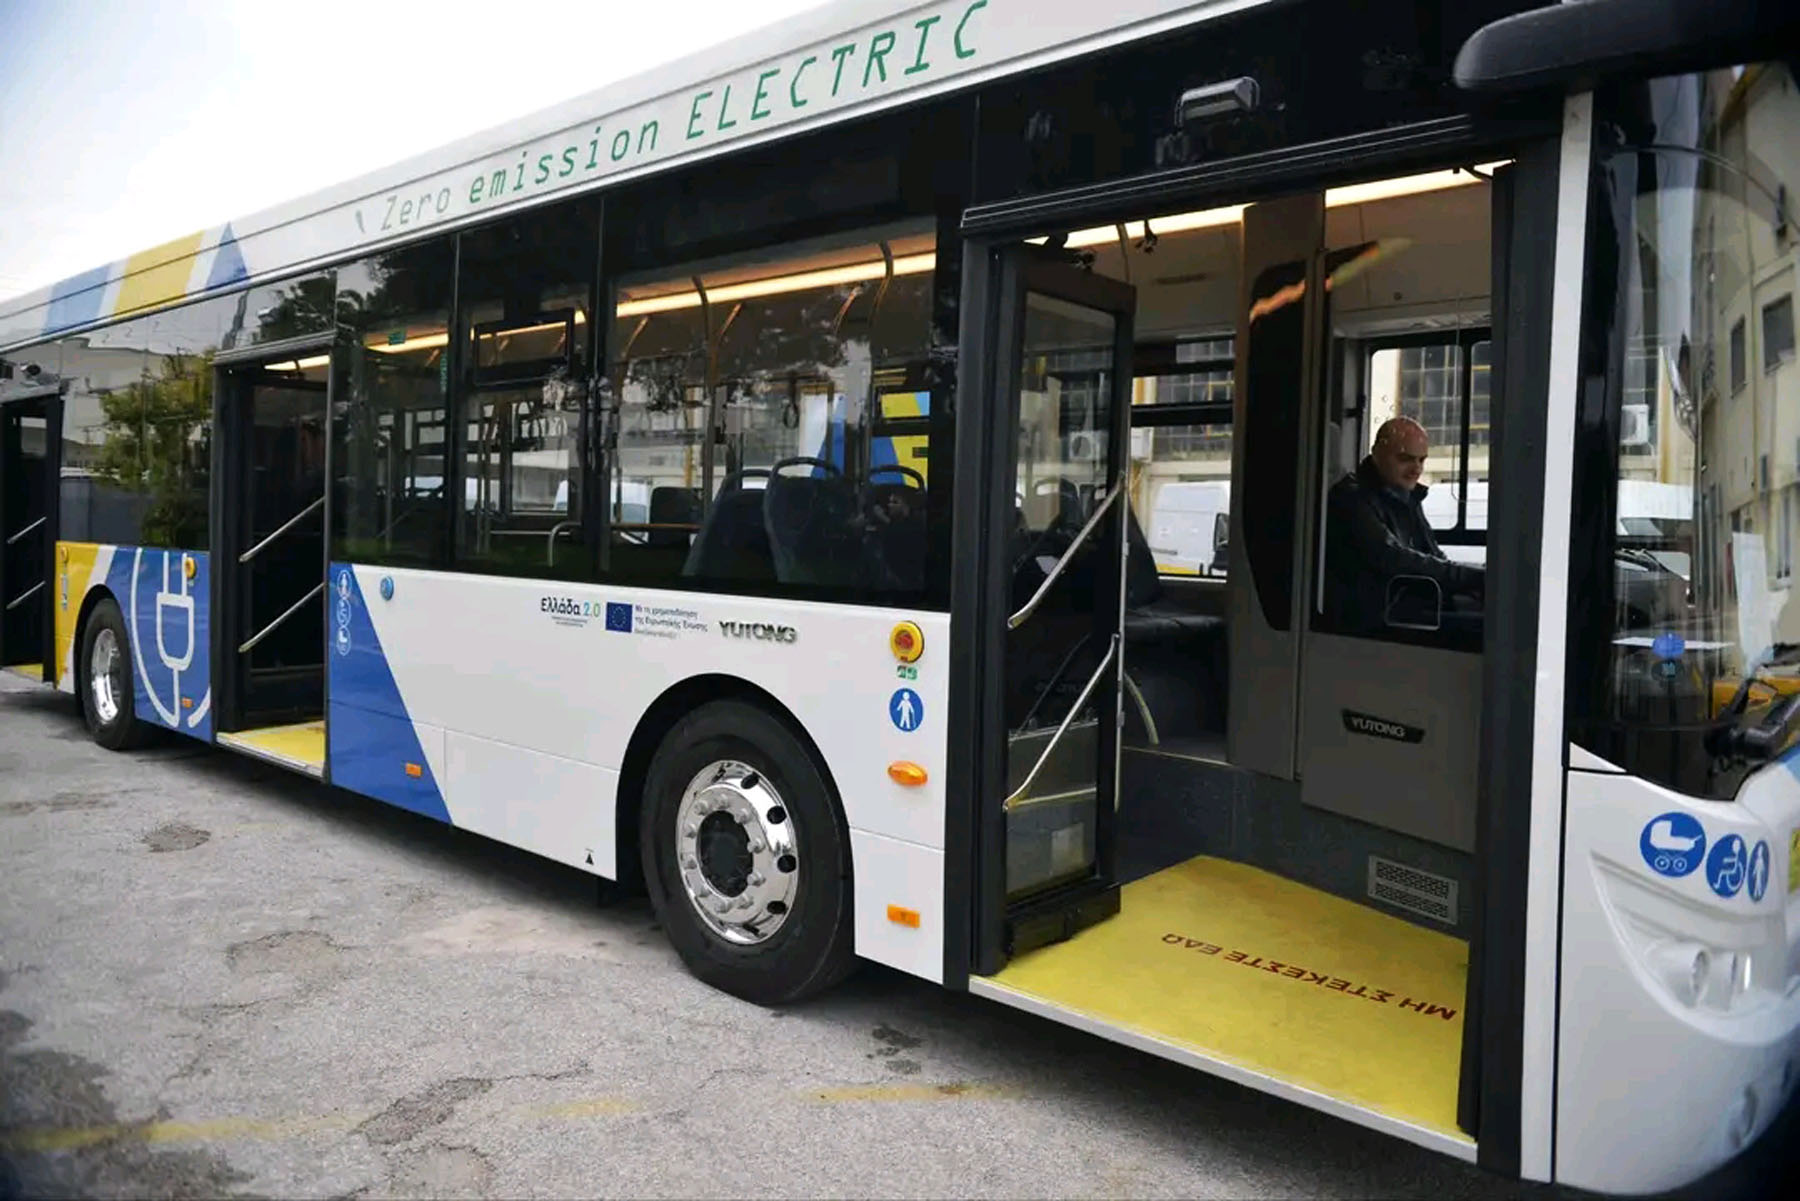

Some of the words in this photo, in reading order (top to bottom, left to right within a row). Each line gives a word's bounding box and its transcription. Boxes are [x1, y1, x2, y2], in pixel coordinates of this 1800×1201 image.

[380, 187, 450, 231] Zero
[469, 120, 659, 204] emission
[686, 0, 988, 140] ELECTRIC
[541, 596, 581, 616] Ελλάδα
[583, 601, 601, 618] 2.0
[719, 620, 797, 643] YUTONG
[1351, 717, 1405, 737] YUTONG
[1161, 932, 1224, 955] ΕΔΩ
[1223, 950, 1396, 1003] ΣΤΕΚΕΣΤΕ
[1399, 997, 1457, 1021] ΜΗ
